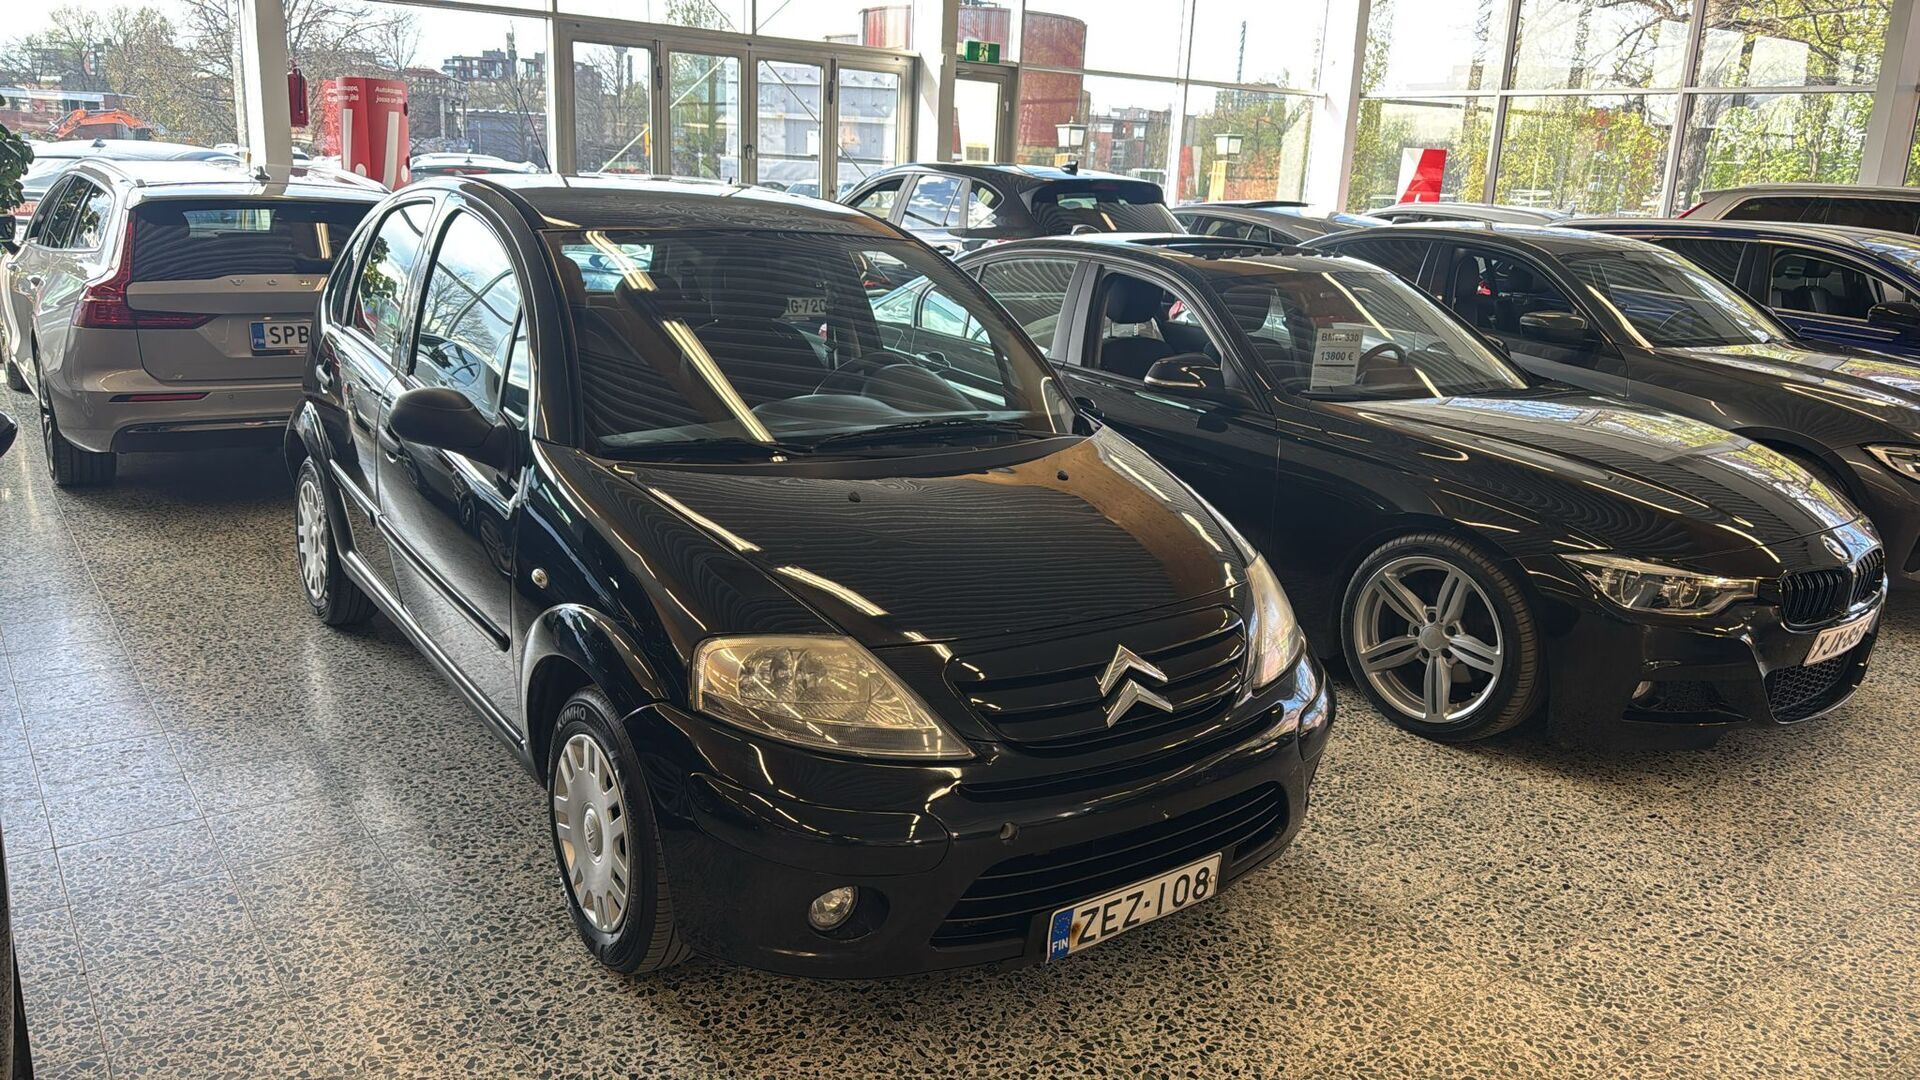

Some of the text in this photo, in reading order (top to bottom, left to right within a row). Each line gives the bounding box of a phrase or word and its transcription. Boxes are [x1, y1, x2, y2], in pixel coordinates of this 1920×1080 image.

[269, 326, 309, 344] SPB
[1344, 333, 1360, 342] 330
[1320, 351, 1354, 361] 13800 €
[557, 706, 587, 731] KUMHO
[1051, 866, 1211, 953] FIN ZEZ-108
